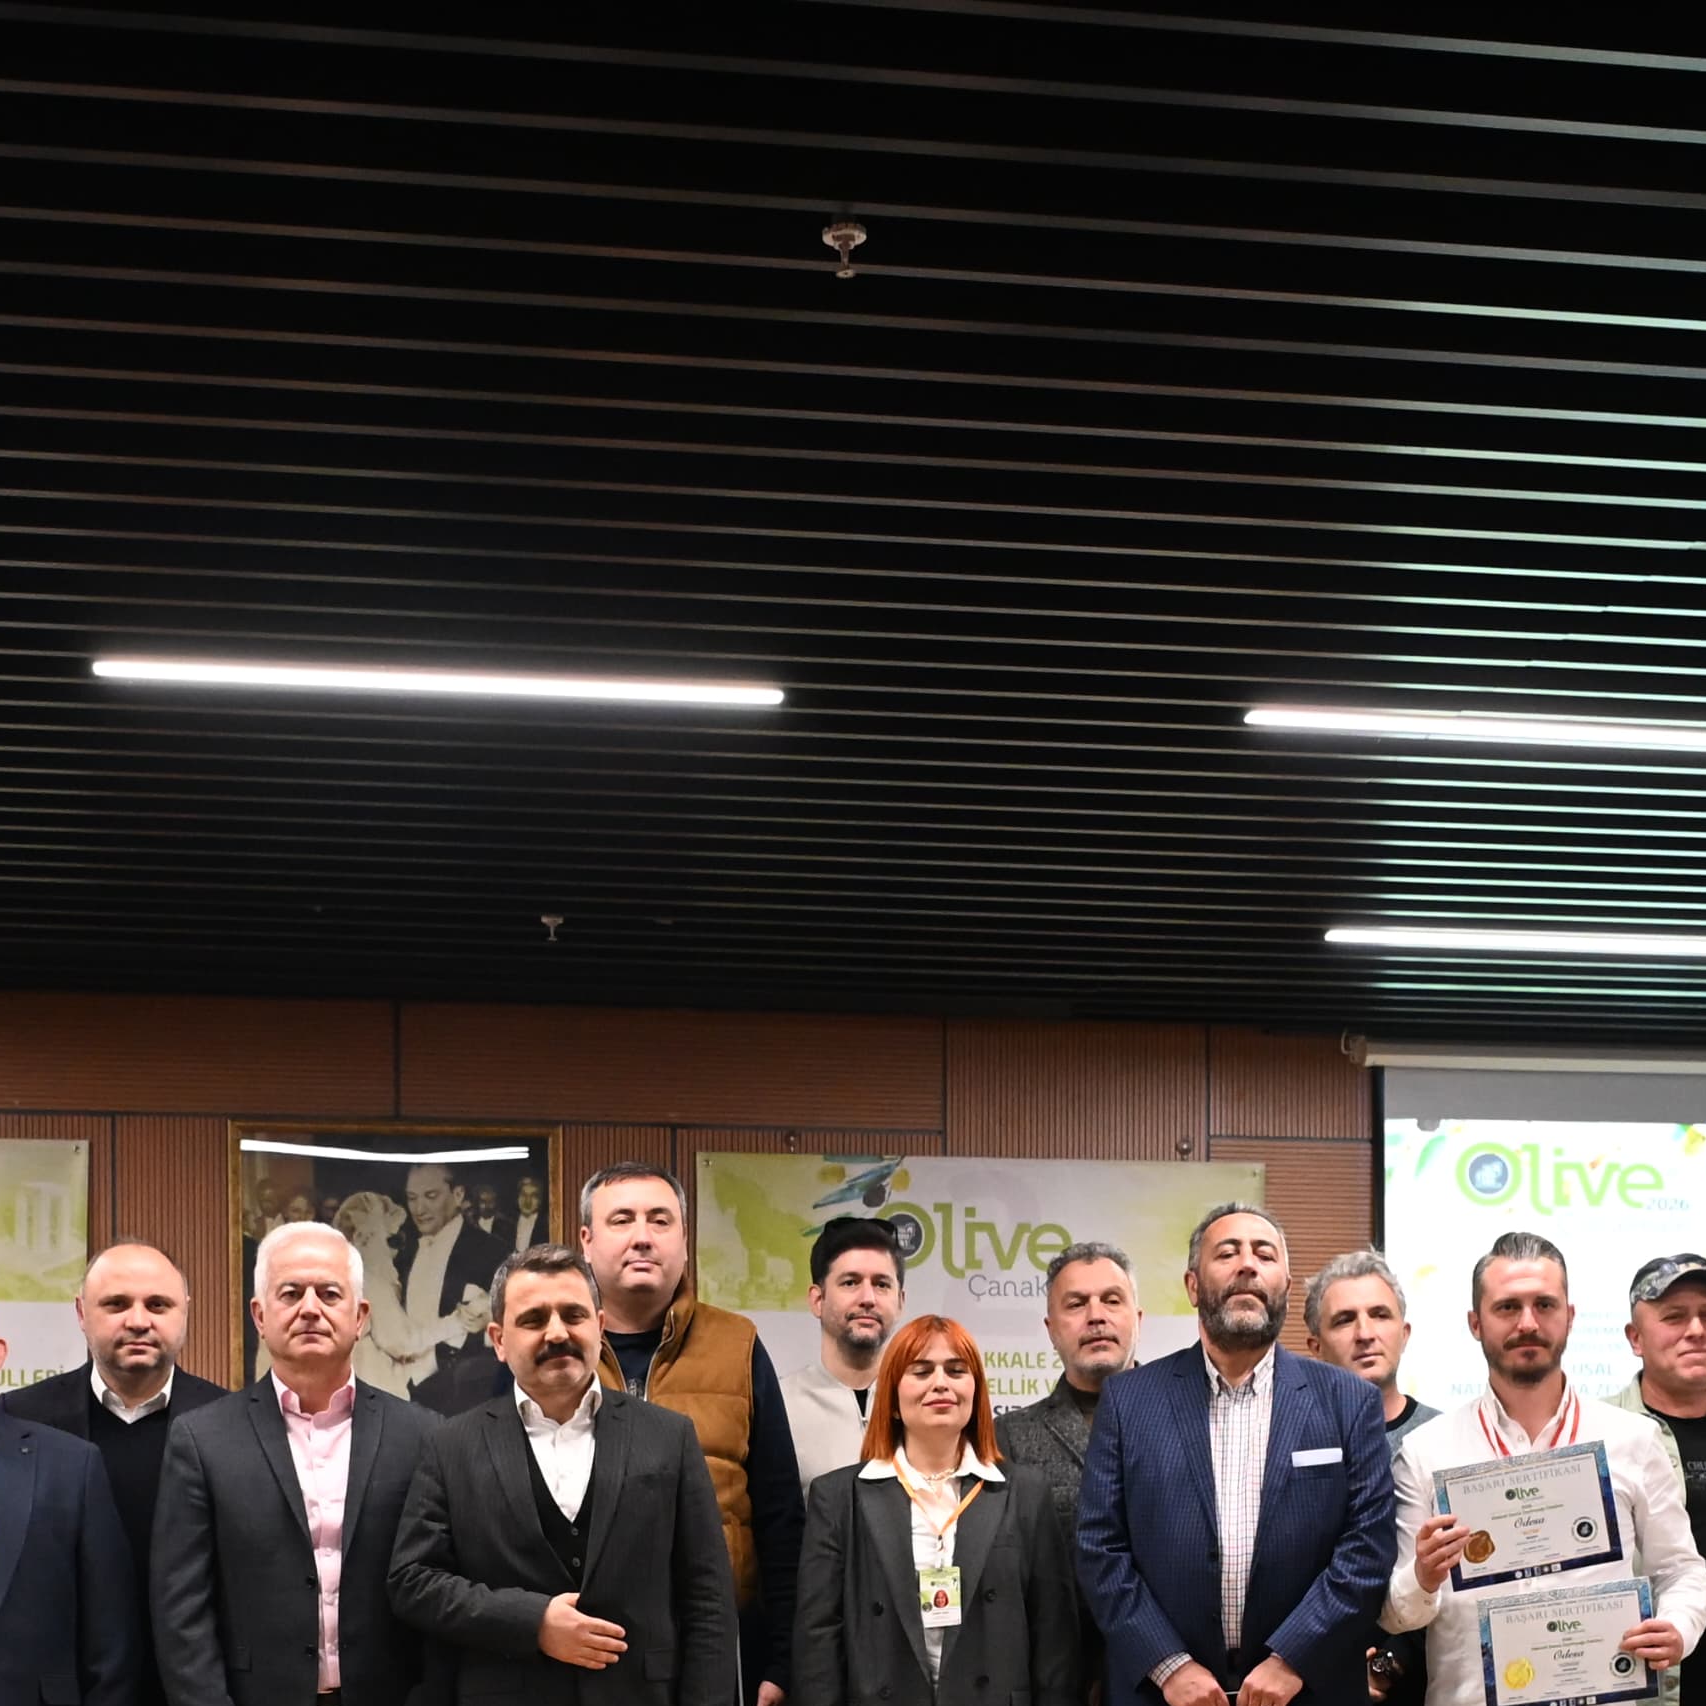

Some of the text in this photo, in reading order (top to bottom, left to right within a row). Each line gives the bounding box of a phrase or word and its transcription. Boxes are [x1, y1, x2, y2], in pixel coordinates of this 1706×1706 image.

[1455, 1142, 1665, 1216] Olive
[875, 1202, 1072, 1279] Olive
[968, 1274, 1049, 1301] Çanak
[984, 1351, 1047, 1369] KKALE
[1505, 1486, 1540, 1501] Olive
[1546, 1619, 1582, 1633] Olive
